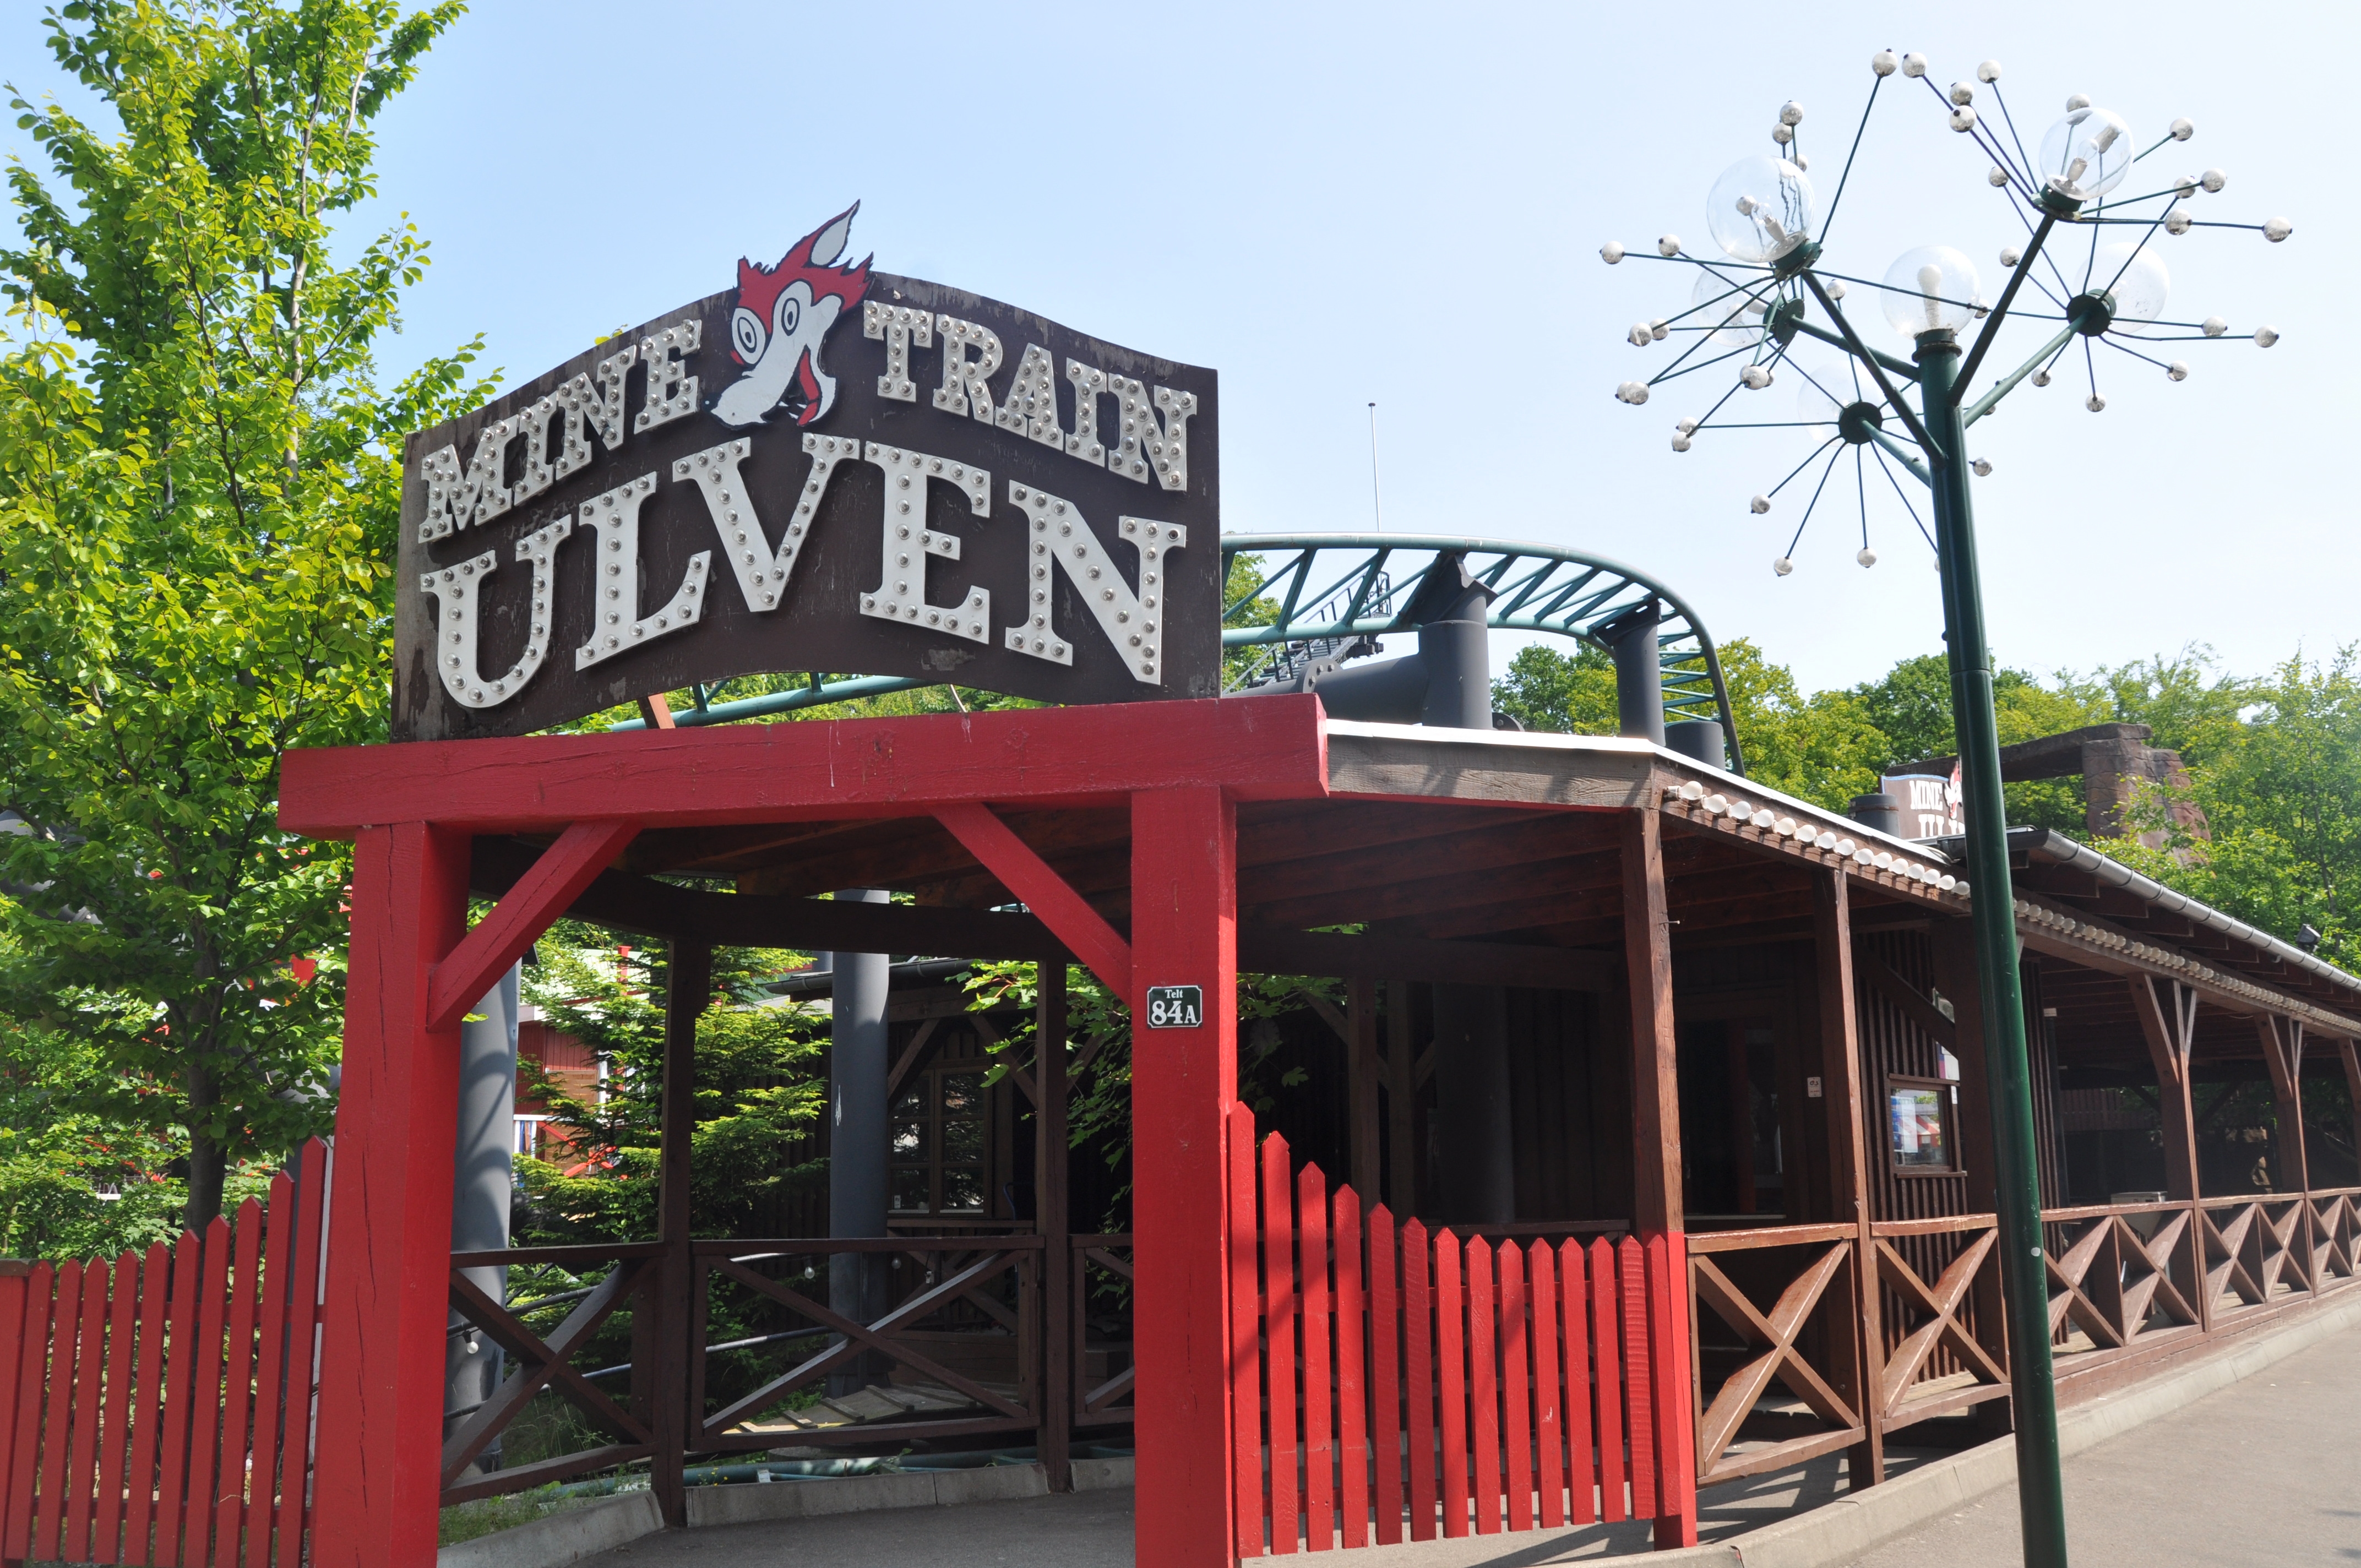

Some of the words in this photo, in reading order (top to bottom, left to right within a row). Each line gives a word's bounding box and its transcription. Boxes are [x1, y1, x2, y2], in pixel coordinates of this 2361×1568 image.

[418, 319, 701, 543] MINE
[863, 300, 1197, 492] TRAIN
[420, 432, 1187, 709] ULVEN
[1909, 780, 1943, 811] MINE
[1165, 989, 1183, 999] Telt
